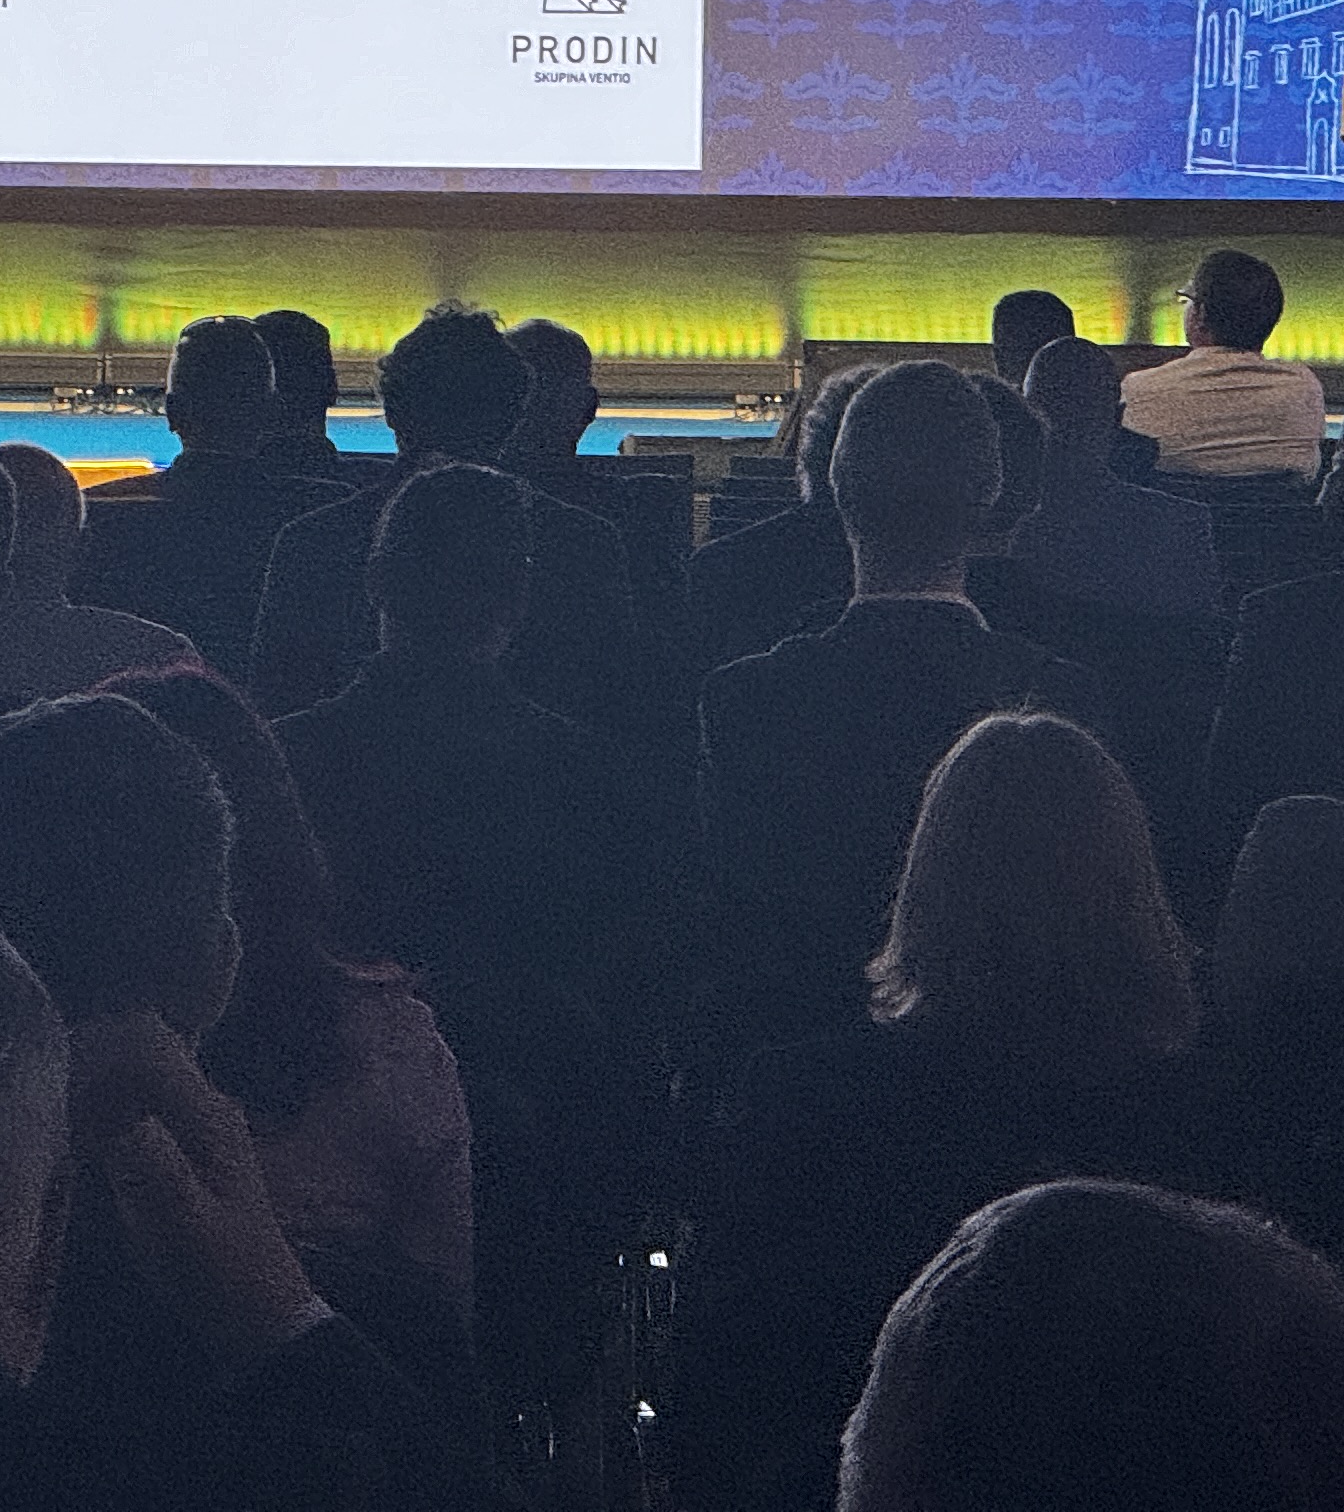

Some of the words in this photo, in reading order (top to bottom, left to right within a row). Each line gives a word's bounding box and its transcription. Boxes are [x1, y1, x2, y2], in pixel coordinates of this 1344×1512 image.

[512, 35, 657, 65] PRODIN
[534, 71, 587, 83] SKUPINA
[588, 72, 631, 84] VENTIO
